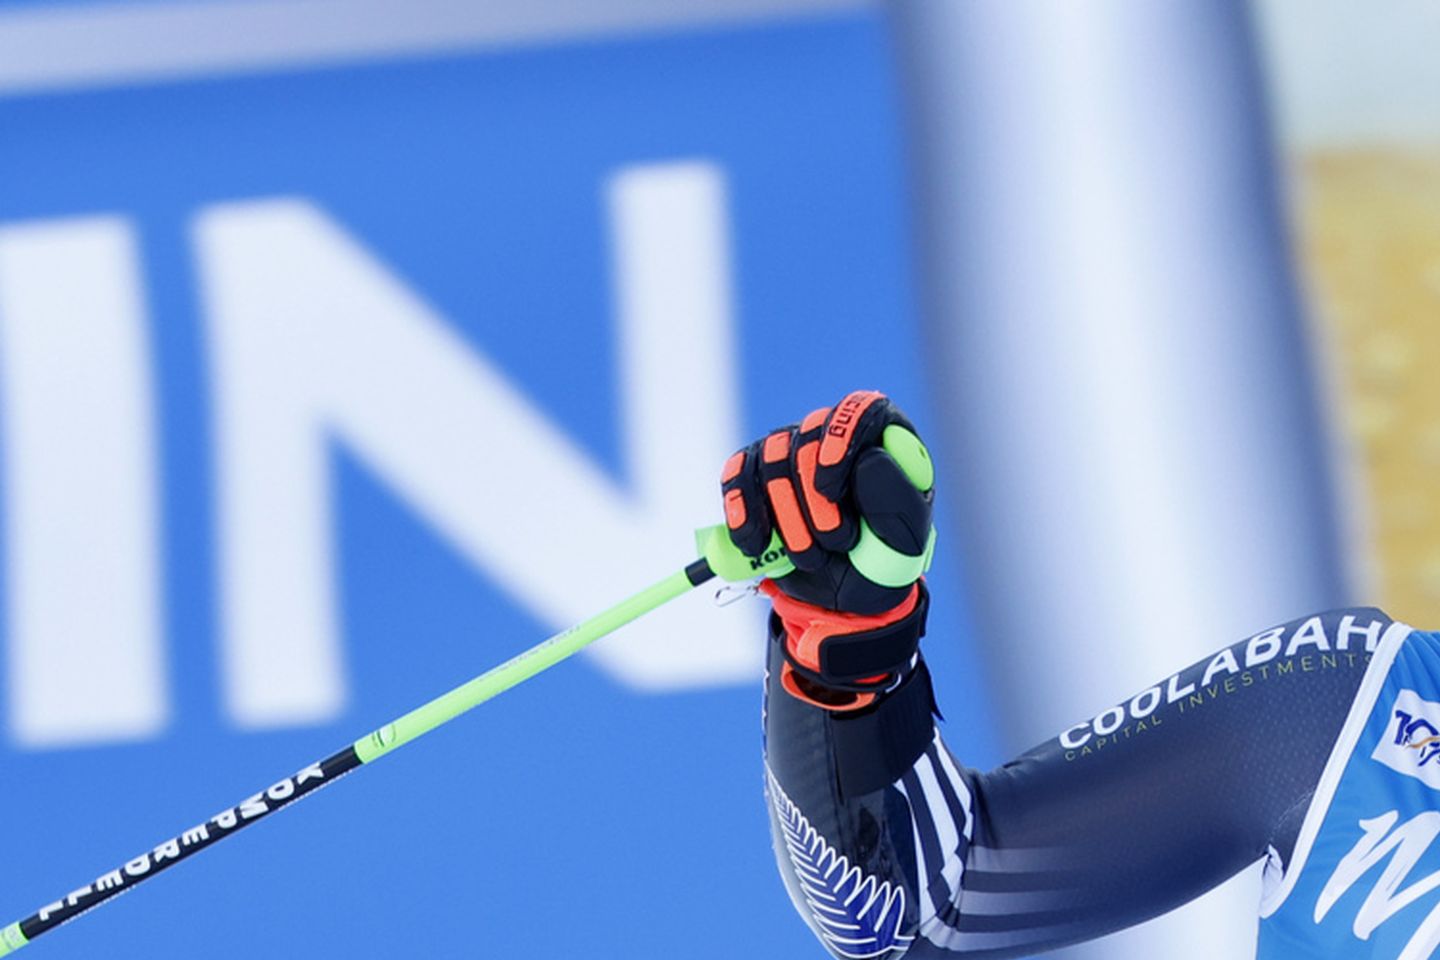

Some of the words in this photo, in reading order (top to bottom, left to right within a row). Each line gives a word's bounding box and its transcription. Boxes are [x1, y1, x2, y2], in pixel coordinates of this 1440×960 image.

[1059, 615, 1383, 749] COOLABAH
[1064, 717, 1163, 762] CAPITAL
[38, 761, 324, 921] KOMPERDELL
